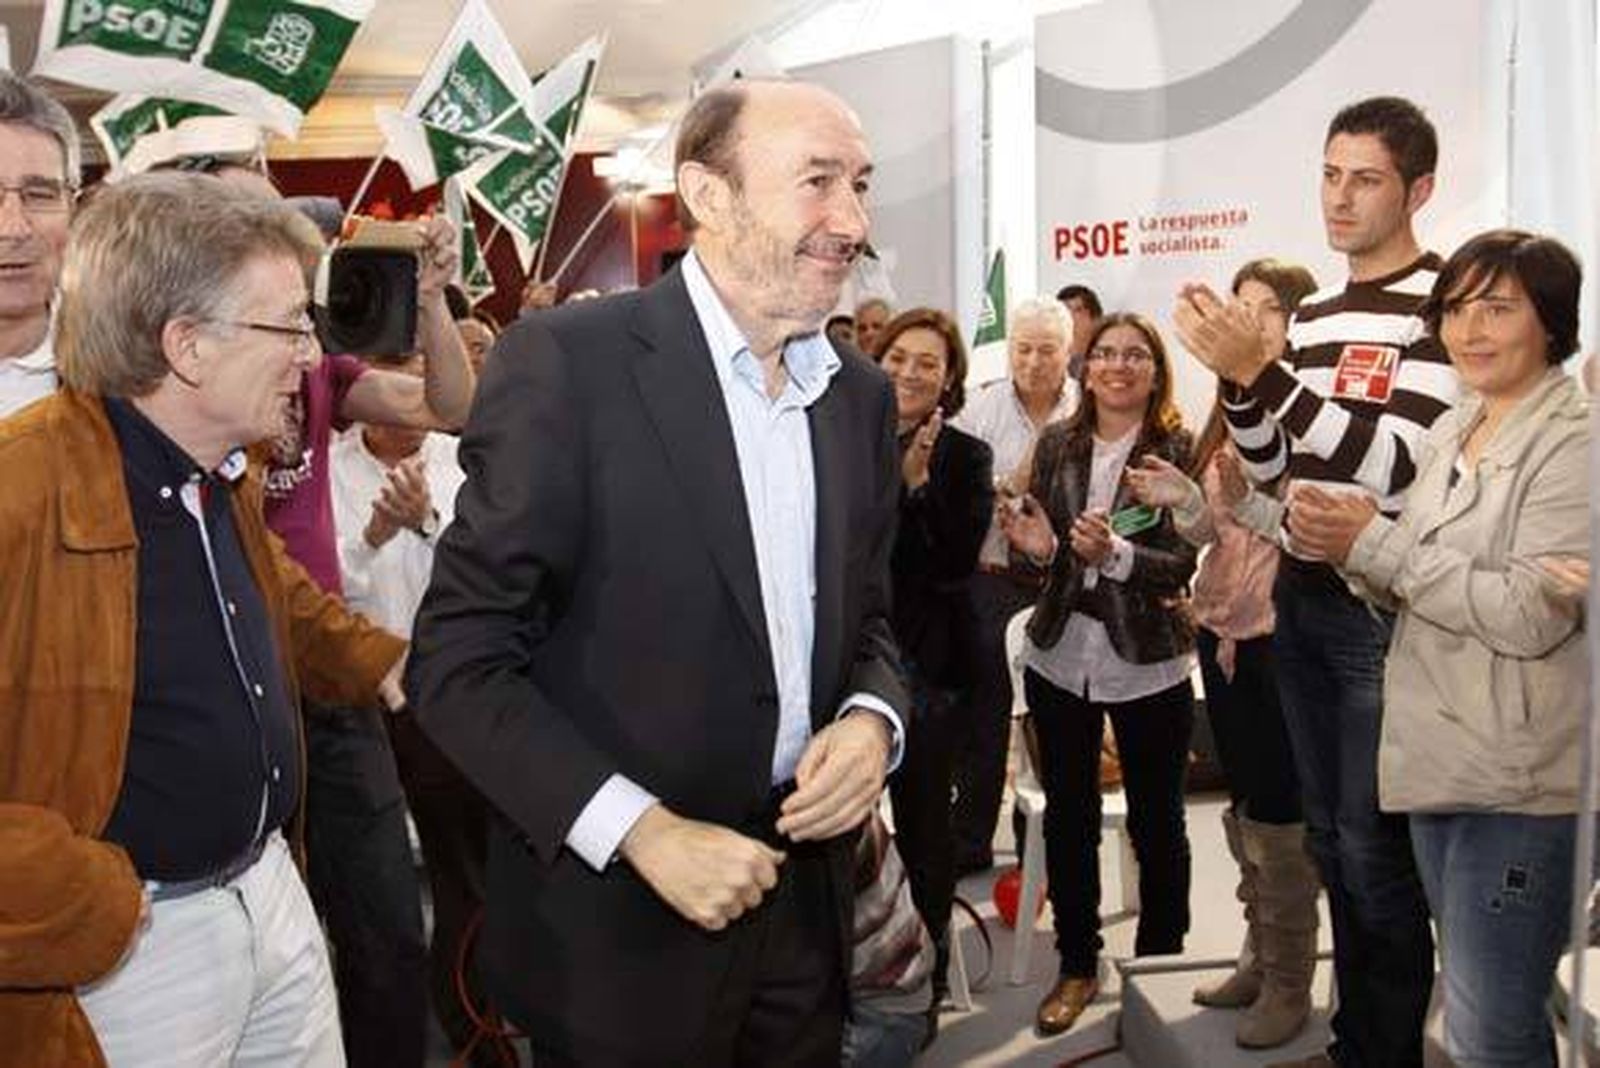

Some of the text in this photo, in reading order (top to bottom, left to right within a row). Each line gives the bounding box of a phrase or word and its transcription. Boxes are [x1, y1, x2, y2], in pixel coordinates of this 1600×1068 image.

[67, 0, 199, 50] PSOE
[1054, 220, 1130, 261] PSOE
[1139, 209, 1248, 232] La respuesta
